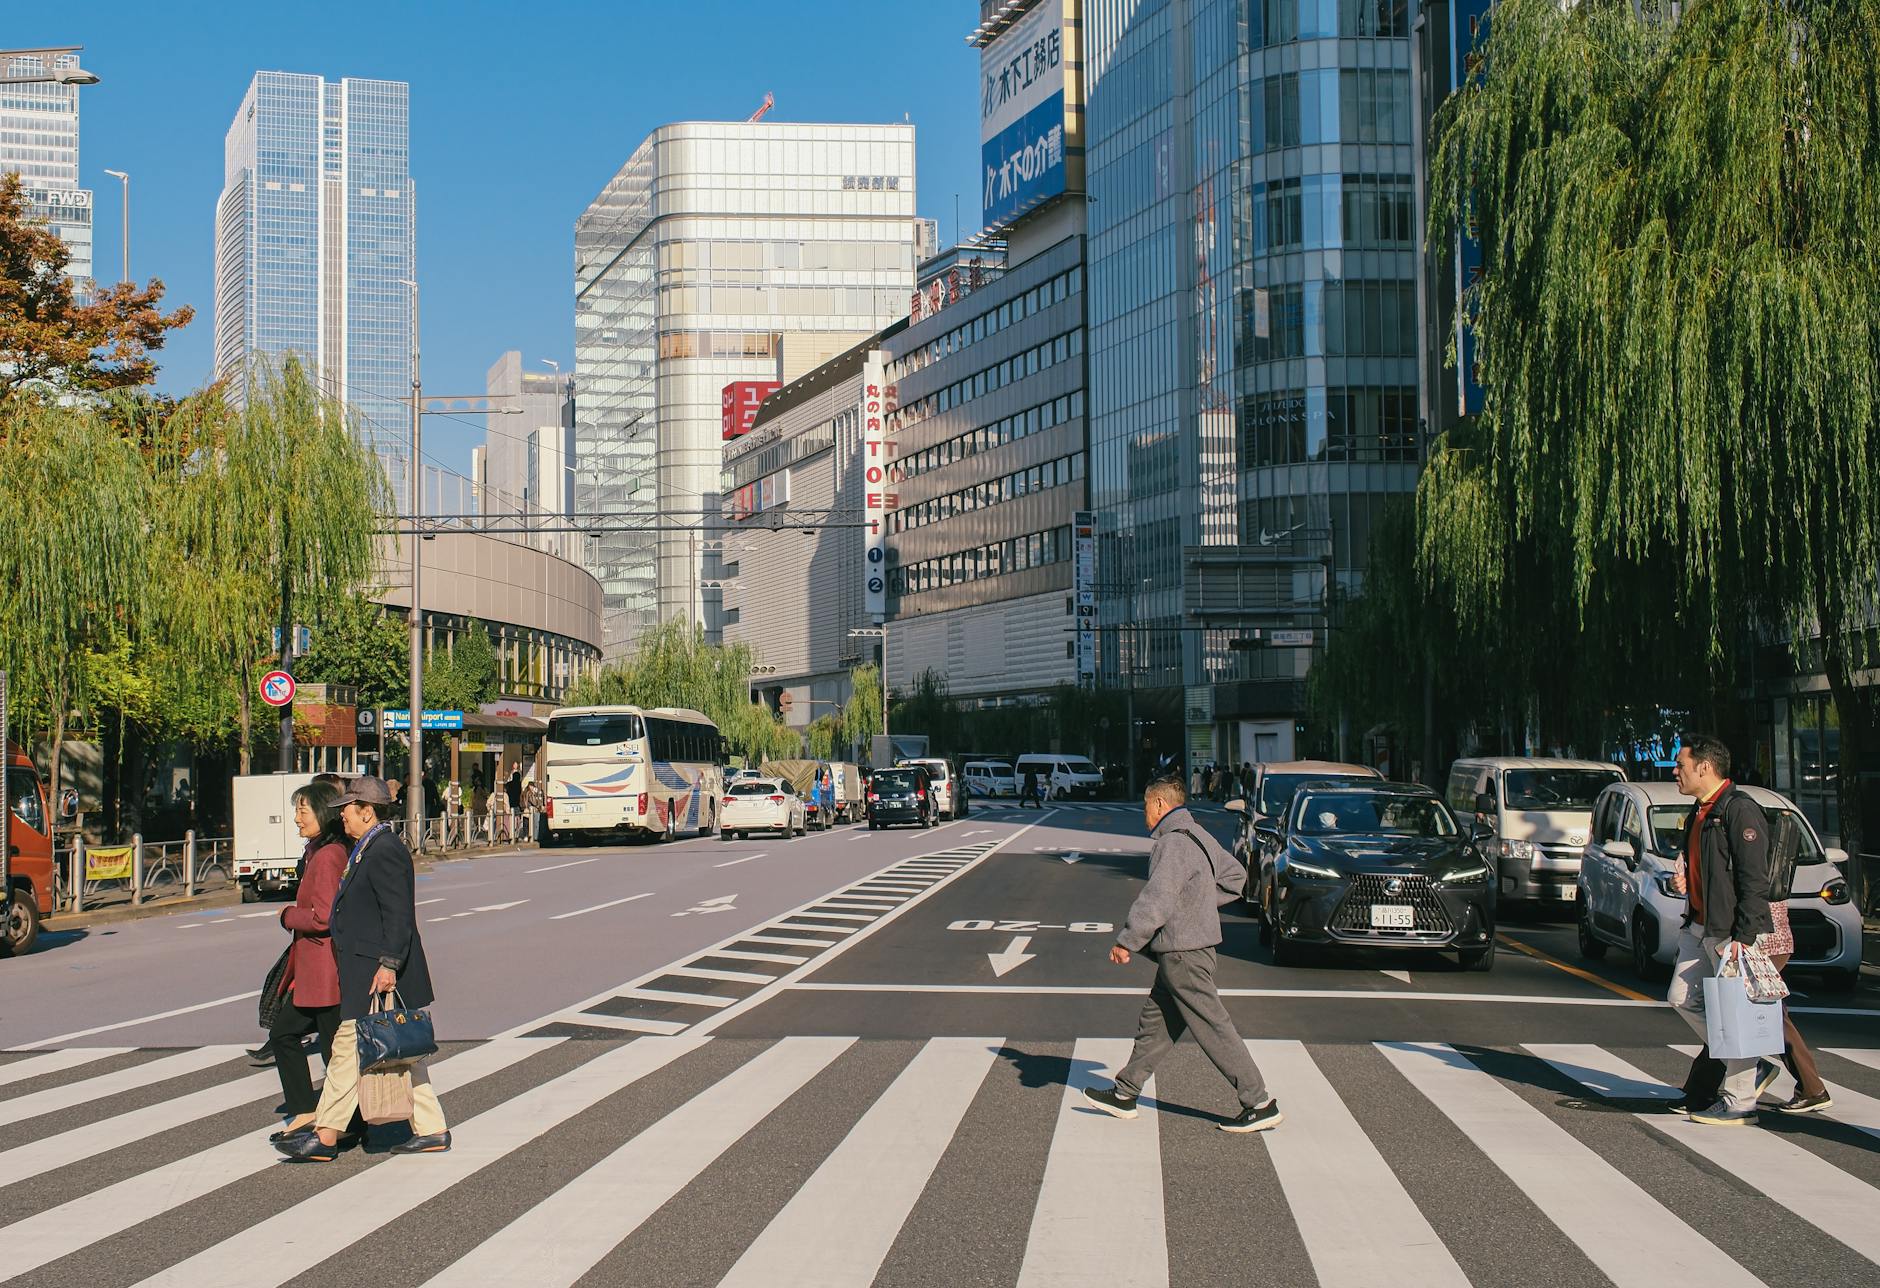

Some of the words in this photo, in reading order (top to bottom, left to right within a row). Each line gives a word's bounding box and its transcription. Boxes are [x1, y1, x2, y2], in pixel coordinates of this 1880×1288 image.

[999, 28, 1060, 105] 木下工務店
[999, 124, 1062, 200] 木下の介護
[1382, 914, 1411, 925] 11-55
